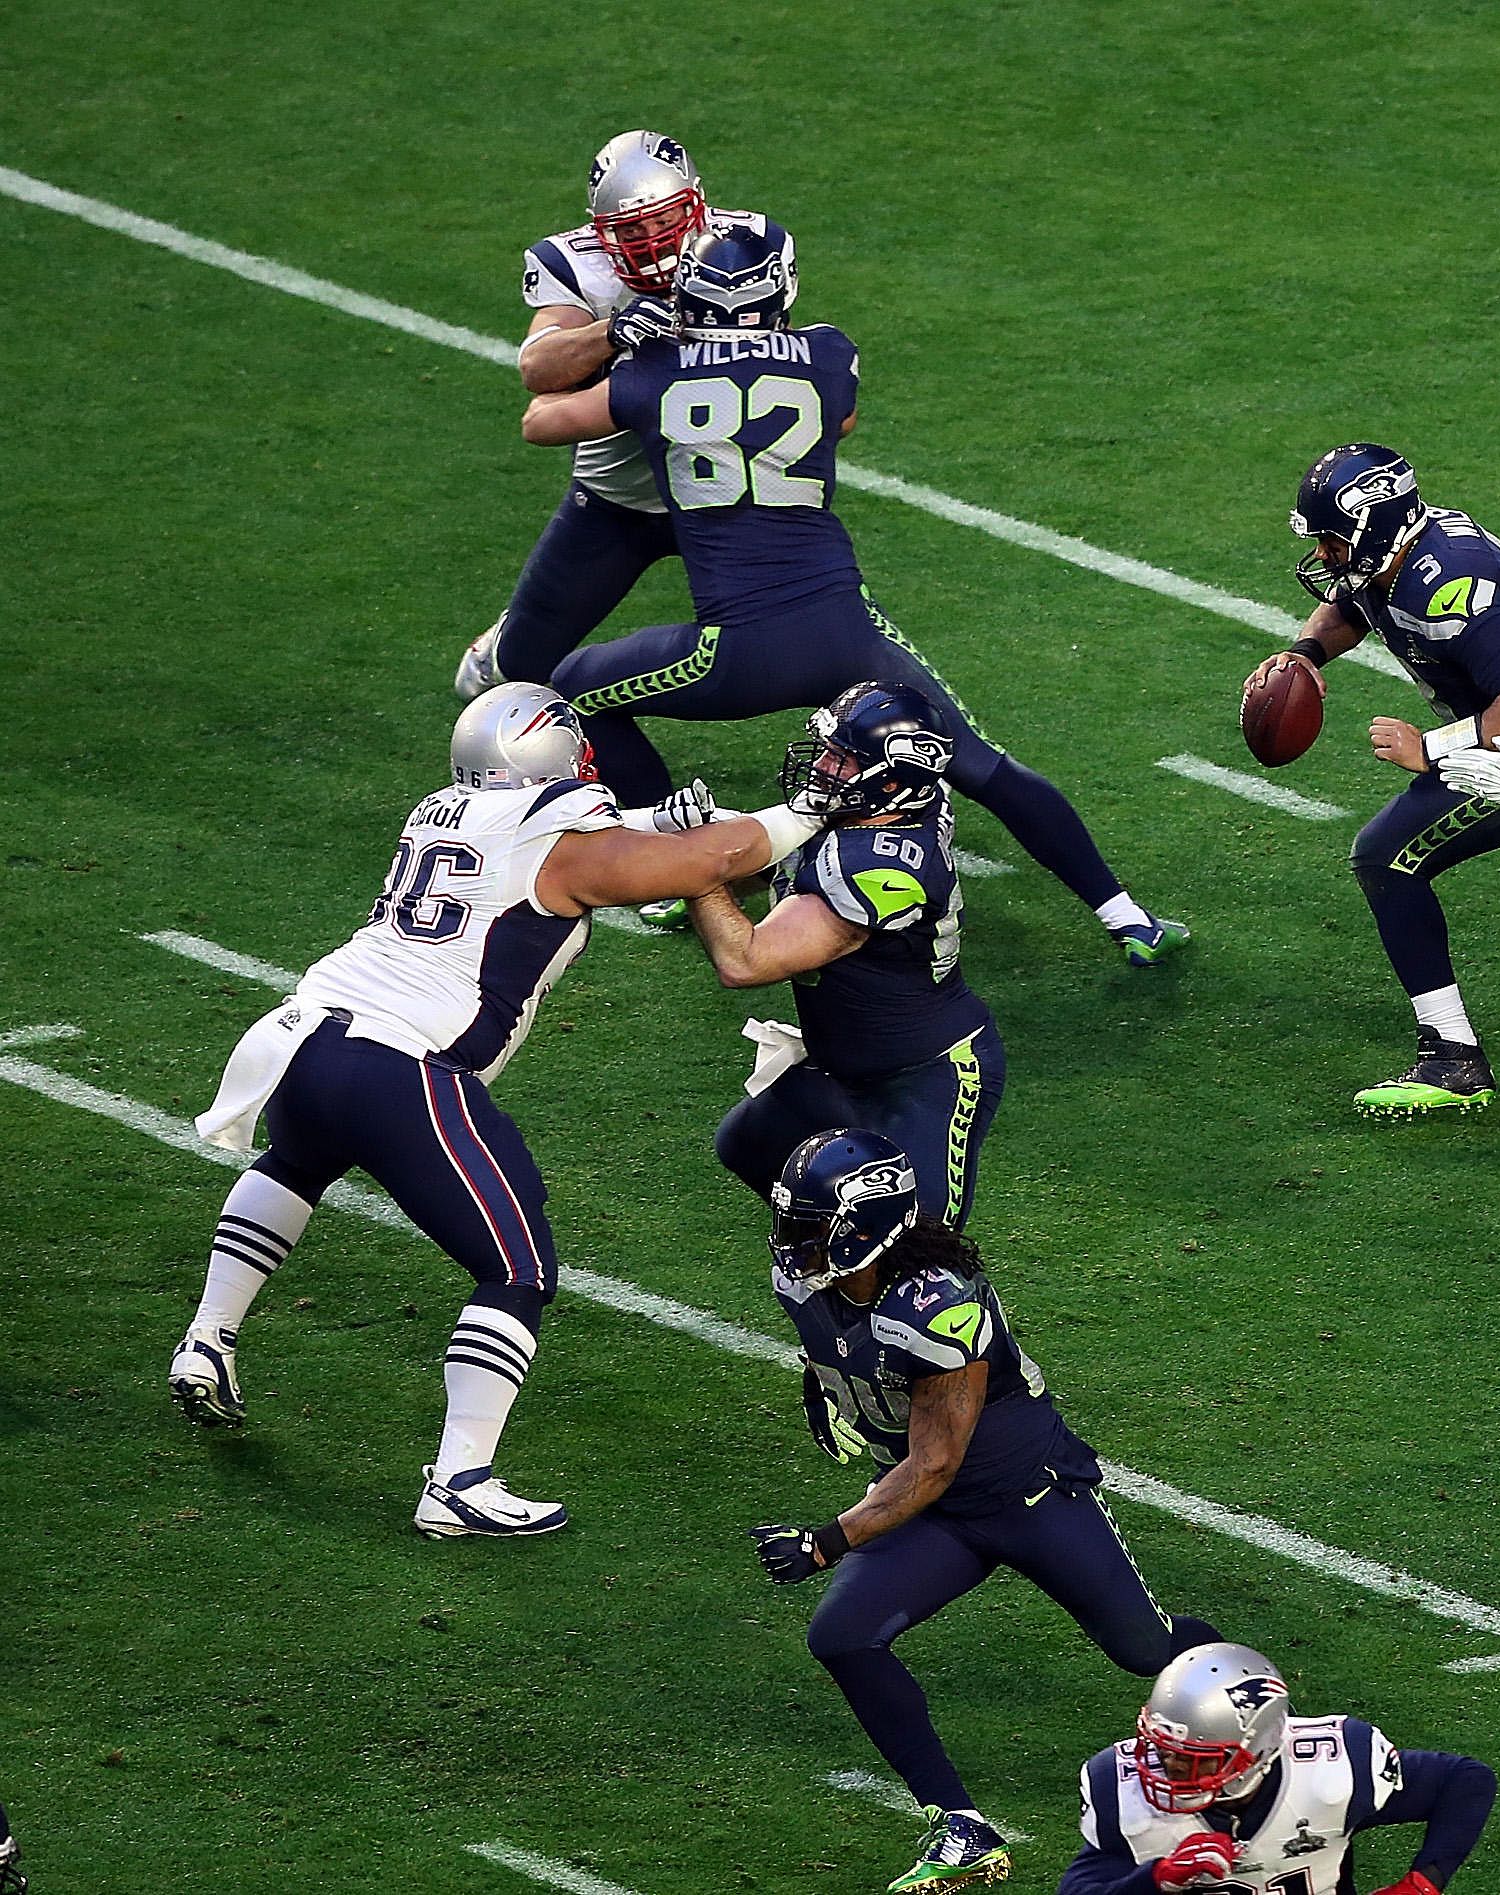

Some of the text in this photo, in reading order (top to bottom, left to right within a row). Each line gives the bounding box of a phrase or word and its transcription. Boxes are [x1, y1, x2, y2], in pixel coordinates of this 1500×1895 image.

[678, 332, 812, 369] WILLSON
[660, 374, 826, 511] 82
[1411, 553, 1443, 586] 3
[456, 766, 482, 789] 96
[872, 830, 925, 871] 60
